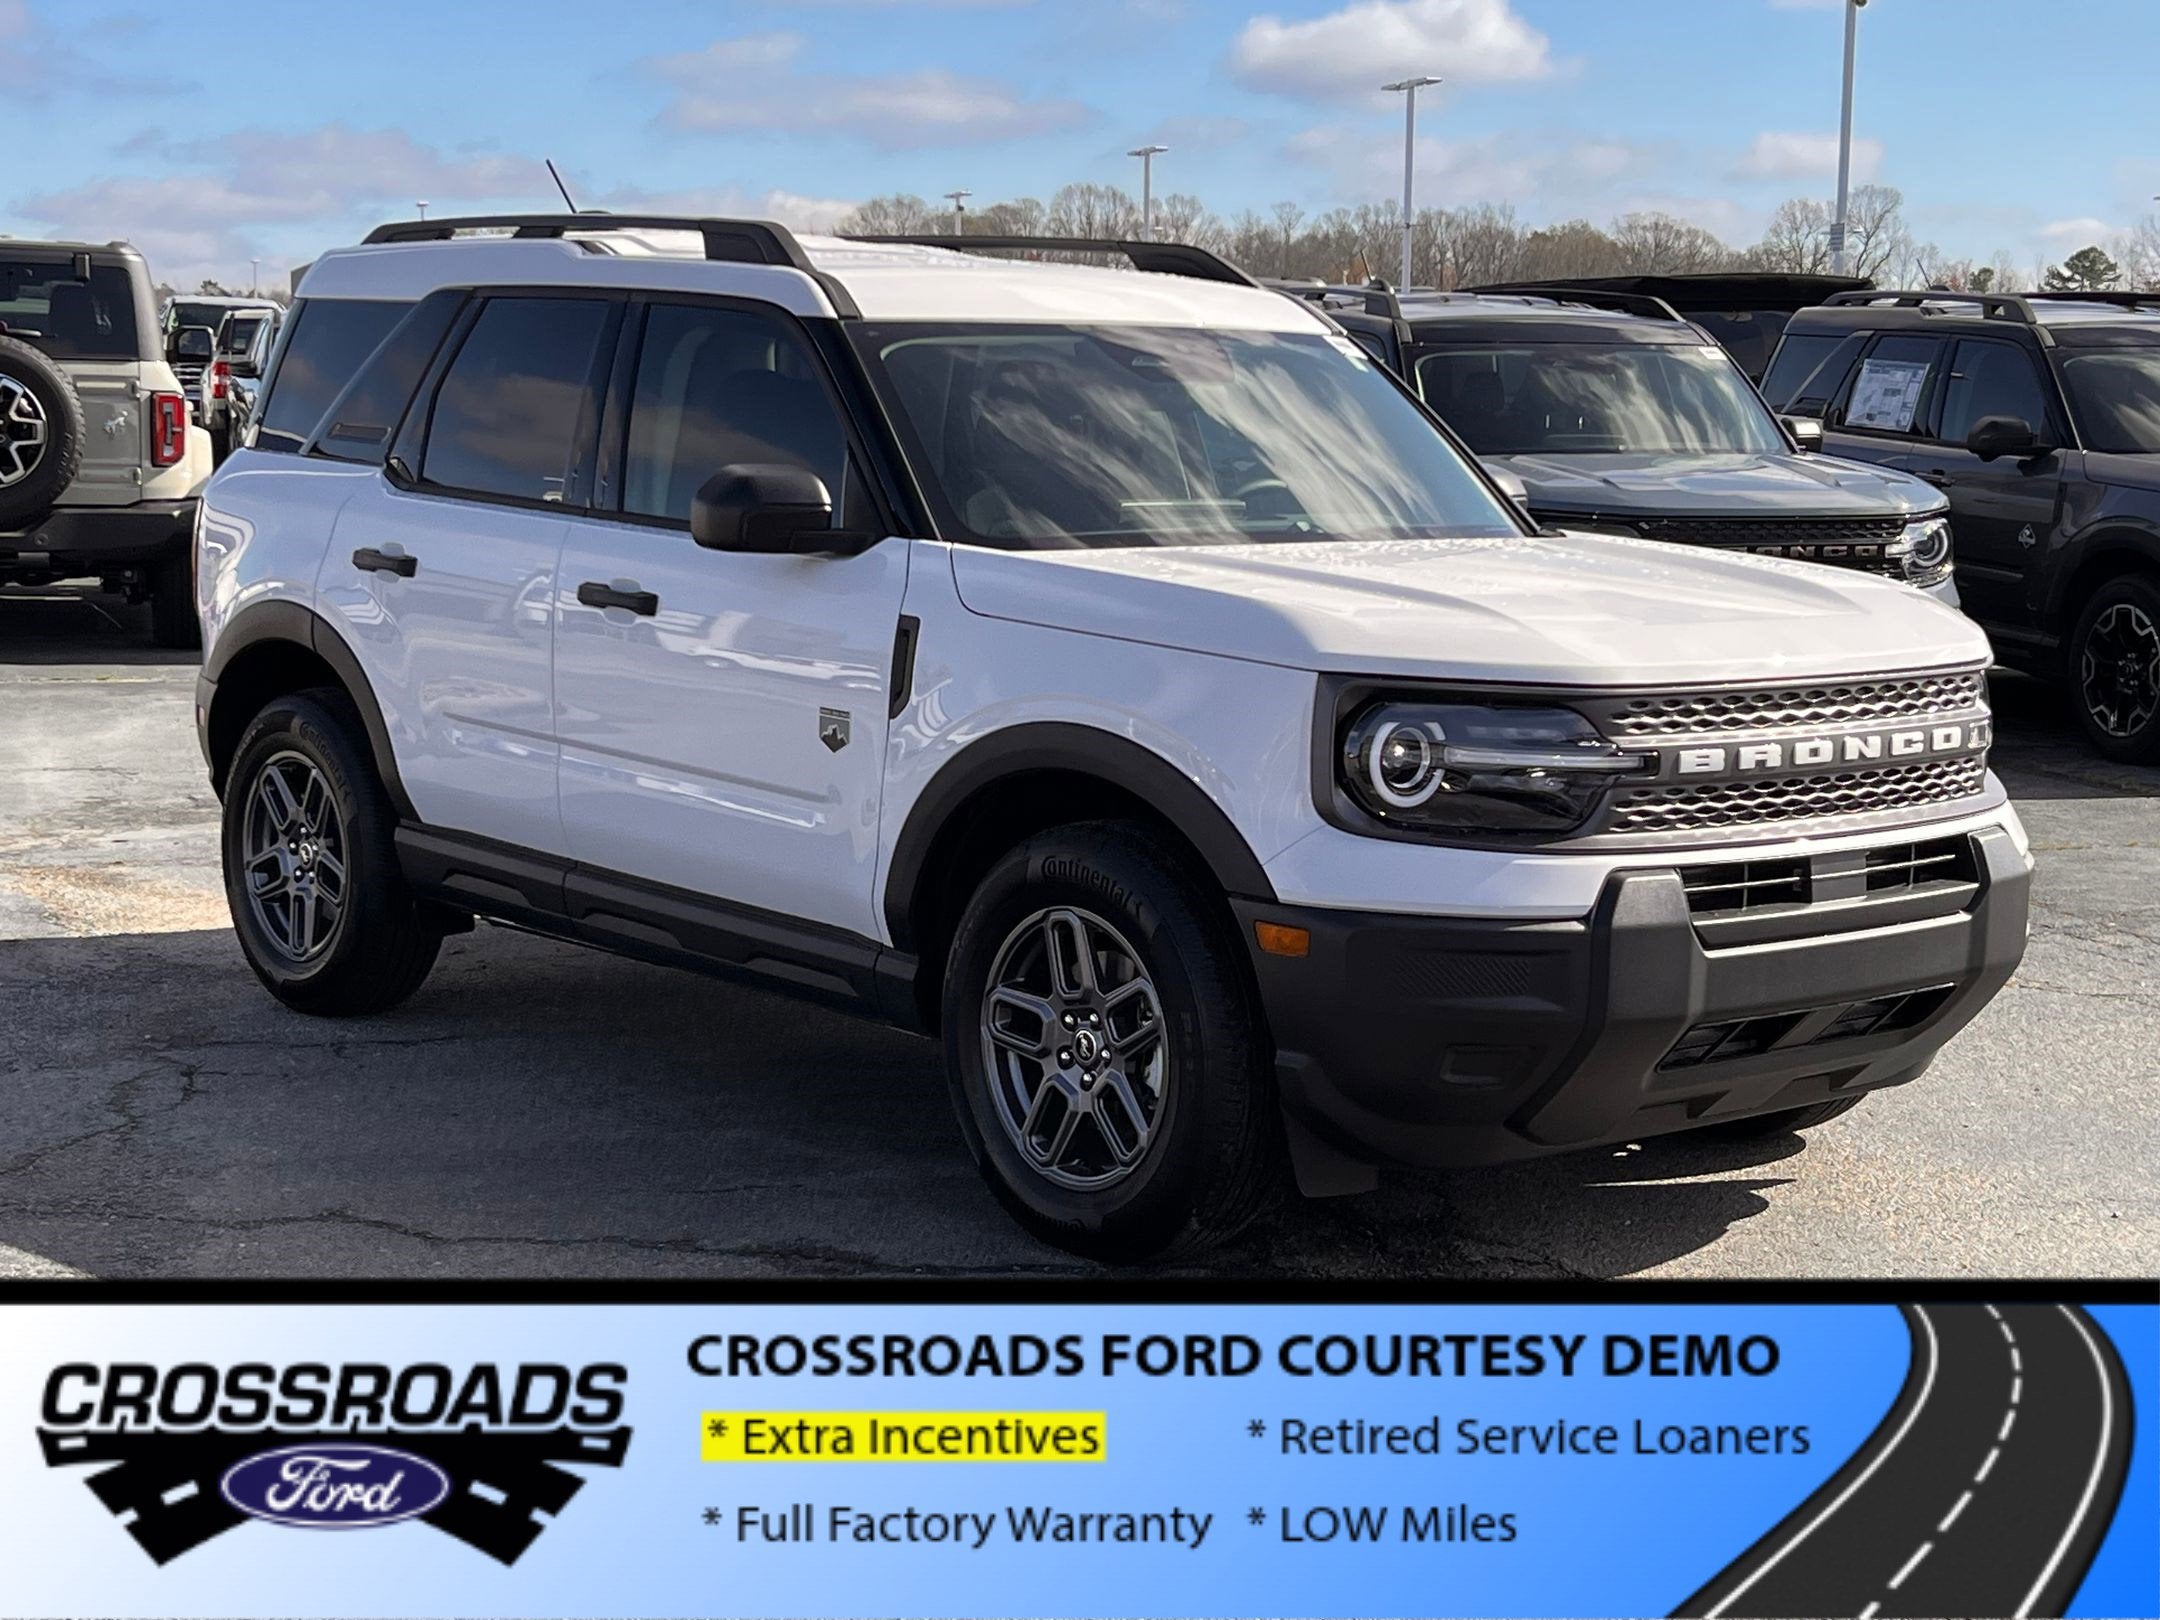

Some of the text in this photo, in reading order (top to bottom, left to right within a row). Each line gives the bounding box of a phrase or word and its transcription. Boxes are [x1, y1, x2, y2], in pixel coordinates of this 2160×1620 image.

[1720, 544, 1879, 559] ONCO
[1678, 726, 1962, 774] BRONCO
[1041, 854, 1134, 910] Continental
